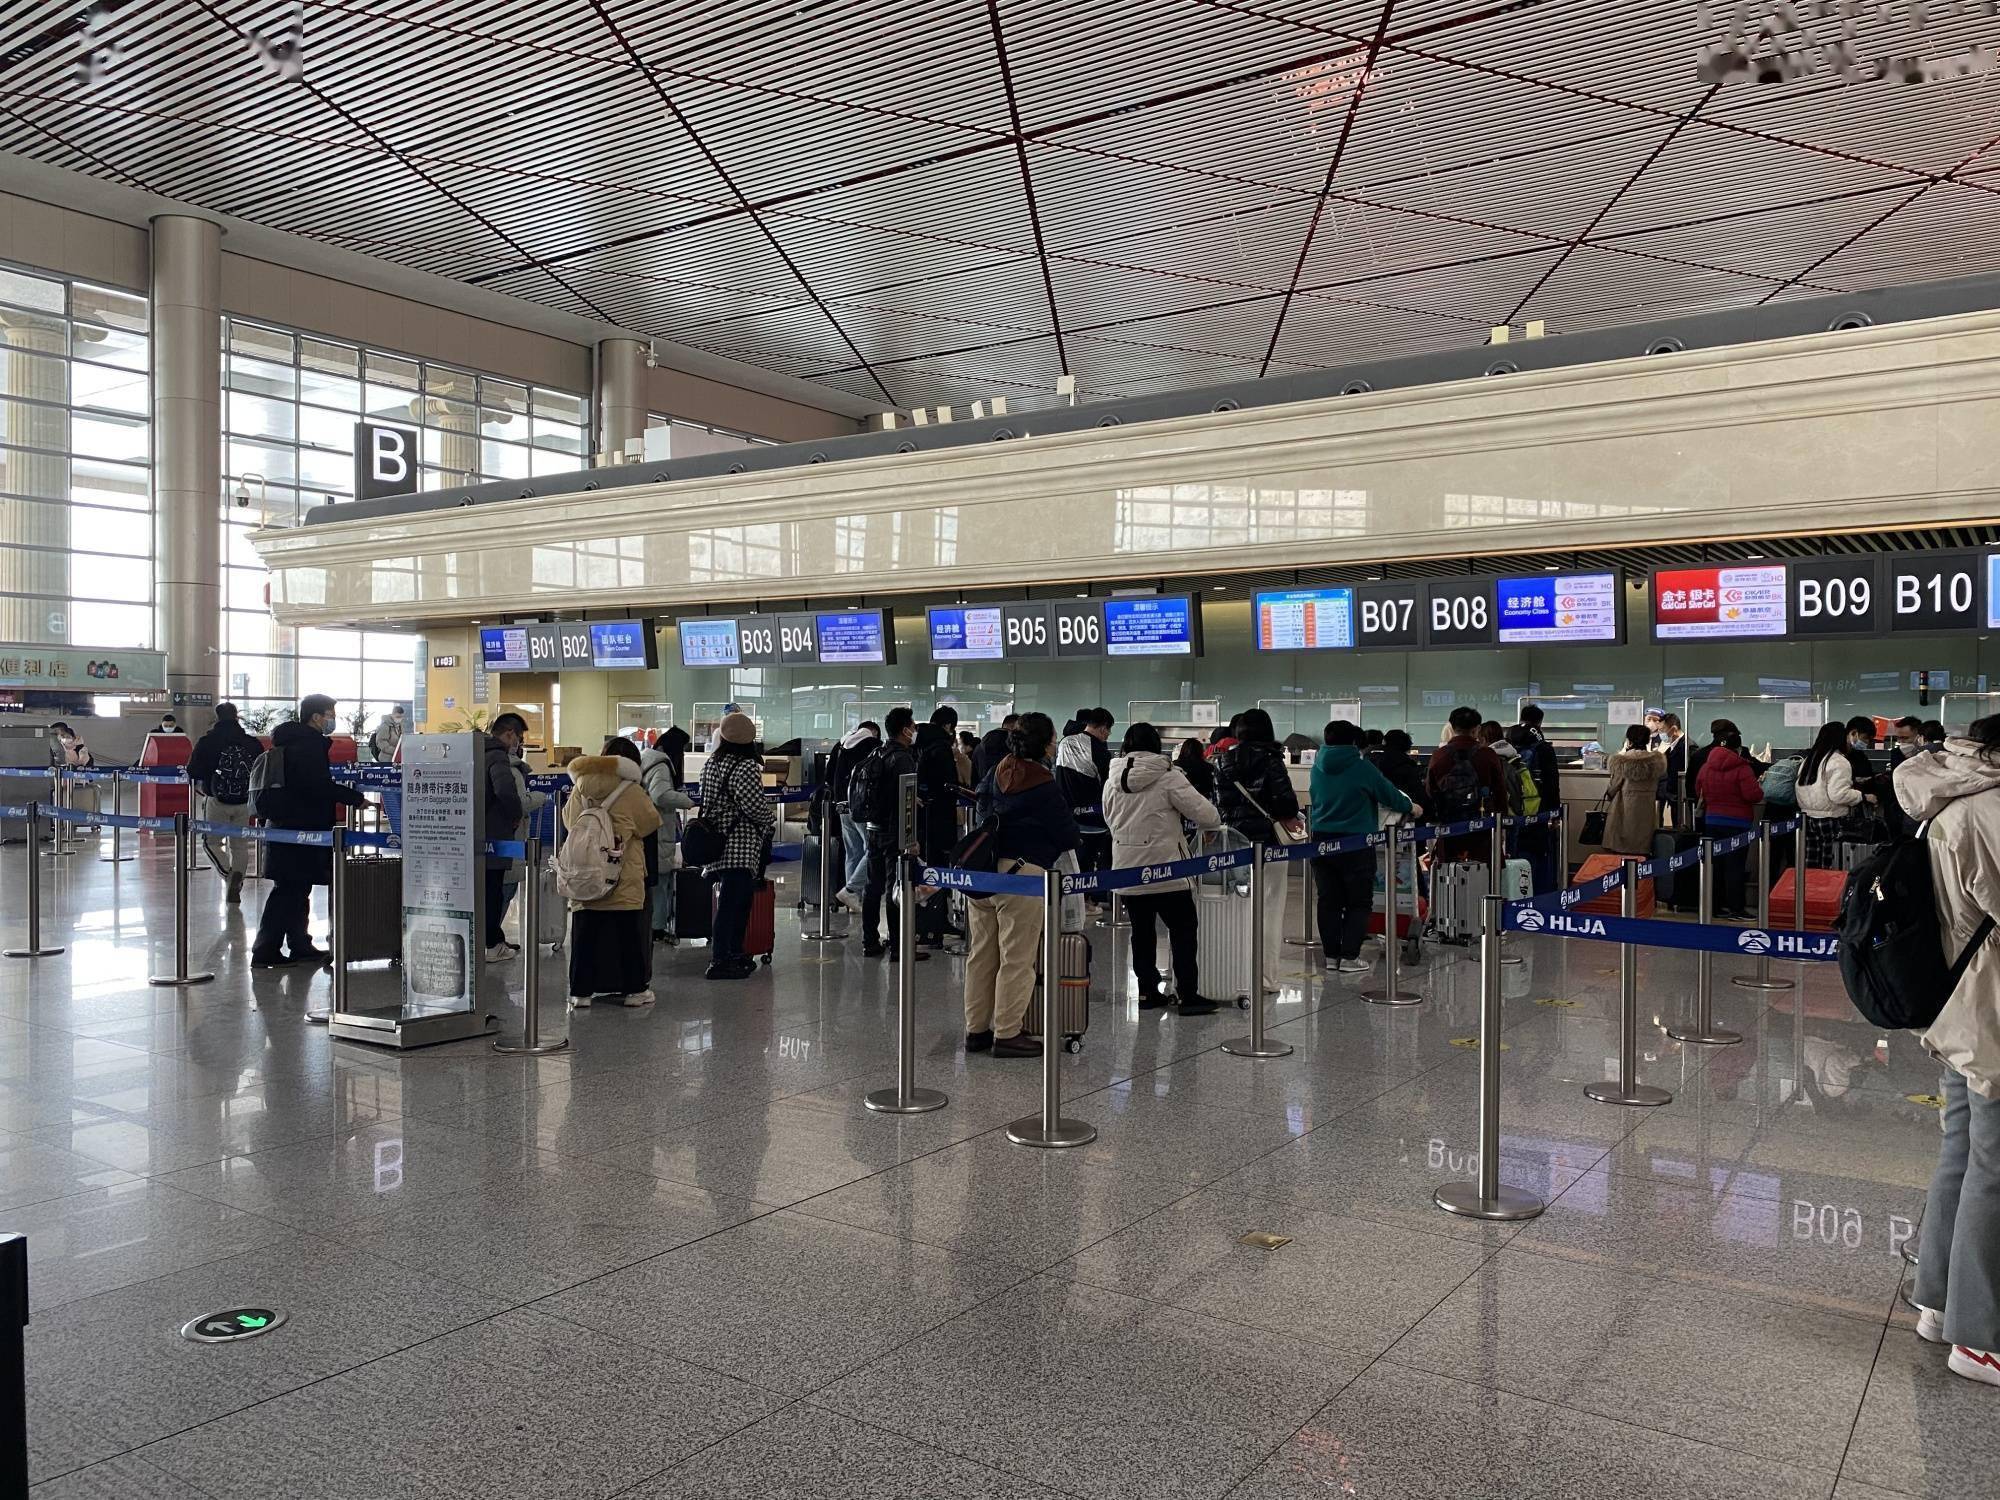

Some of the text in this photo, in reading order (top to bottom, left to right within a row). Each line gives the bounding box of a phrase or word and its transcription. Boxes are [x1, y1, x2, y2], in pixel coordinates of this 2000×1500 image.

[373, 428, 407, 482] B
[1799, 577, 1870, 617] B09
[1896, 572, 1972, 614] B10
[1507, 596, 1545, 608] 经济舱
[1362, 599, 1414, 632] B07
[1432, 596, 1487, 630] B08
[1007, 617, 1046, 645] B05
[1058, 615, 1099, 645] B06
[562, 635, 589, 658] B02
[601, 633, 632, 645] 团队柜台
[741, 629, 773, 654] B03
[781, 627, 812, 652] B04
[531, 636, 556, 659] B01
[407, 782, 468, 794] 随身携带行李须知
[1081, 806, 1095, 814] HLJA
[93, 815, 109, 823] HLJA
[145, 818, 161, 827] HLJA
[250, 829, 266, 838] HLJA
[305, 832, 322, 842] HLJA
[1374, 832, 1386, 843] HLJA
[1273, 848, 1289, 858] HLJA
[1326, 841, 1341, 852] HLJA
[1219, 855, 1235, 867] HLJA
[941, 872, 973, 887] HLJA
[1152, 866, 1172, 878] HLJA
[1075, 876, 1098, 889] HLJA
[1608, 872, 1620, 888] HLJA
[1567, 888, 1581, 904] HLJA
[1550, 915, 1606, 936] HLJA
